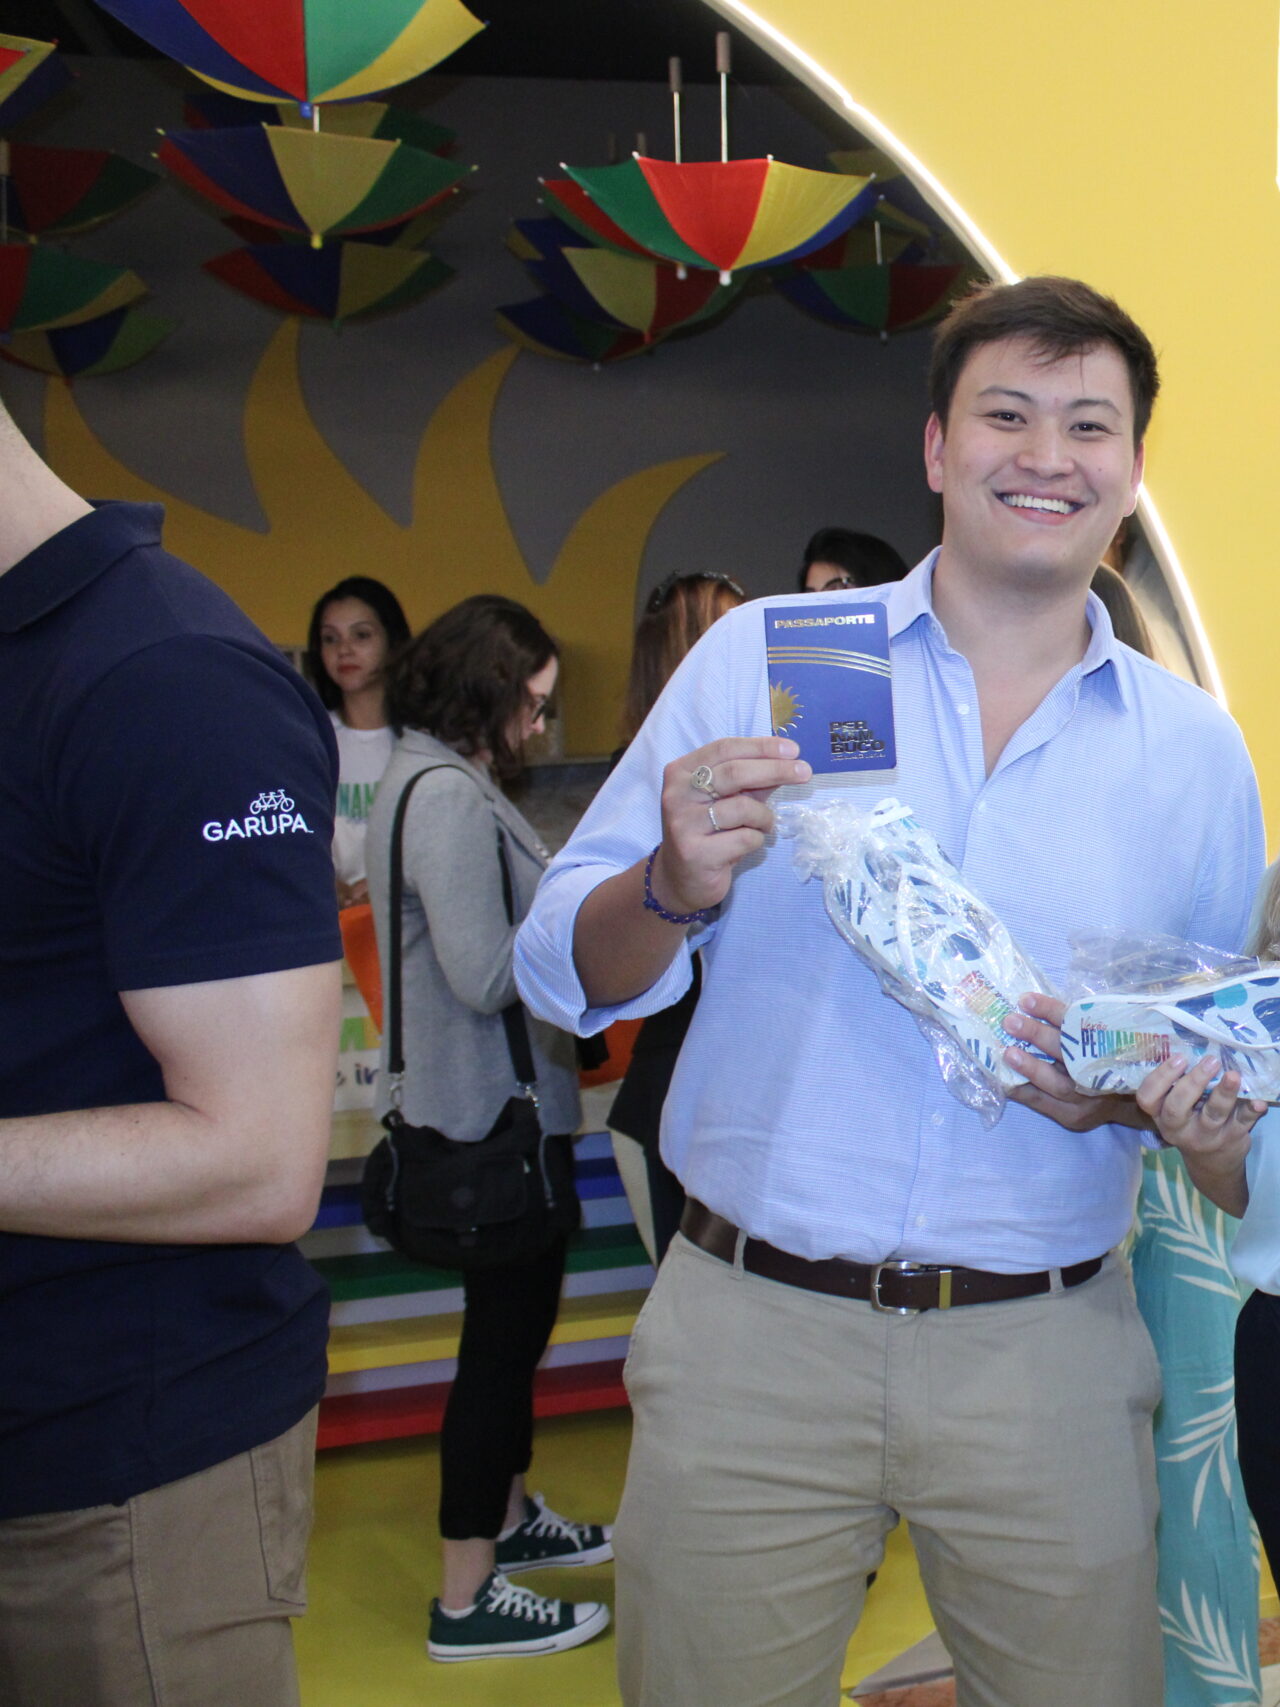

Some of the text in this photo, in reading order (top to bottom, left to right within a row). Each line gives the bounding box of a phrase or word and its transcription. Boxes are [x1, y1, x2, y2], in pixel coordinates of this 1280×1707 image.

[774, 614, 875, 629] PASSAPORTE
[830, 720, 868, 734] PER
[831, 740, 885, 755] BUCO
[203, 813, 310, 841] GARUPA
